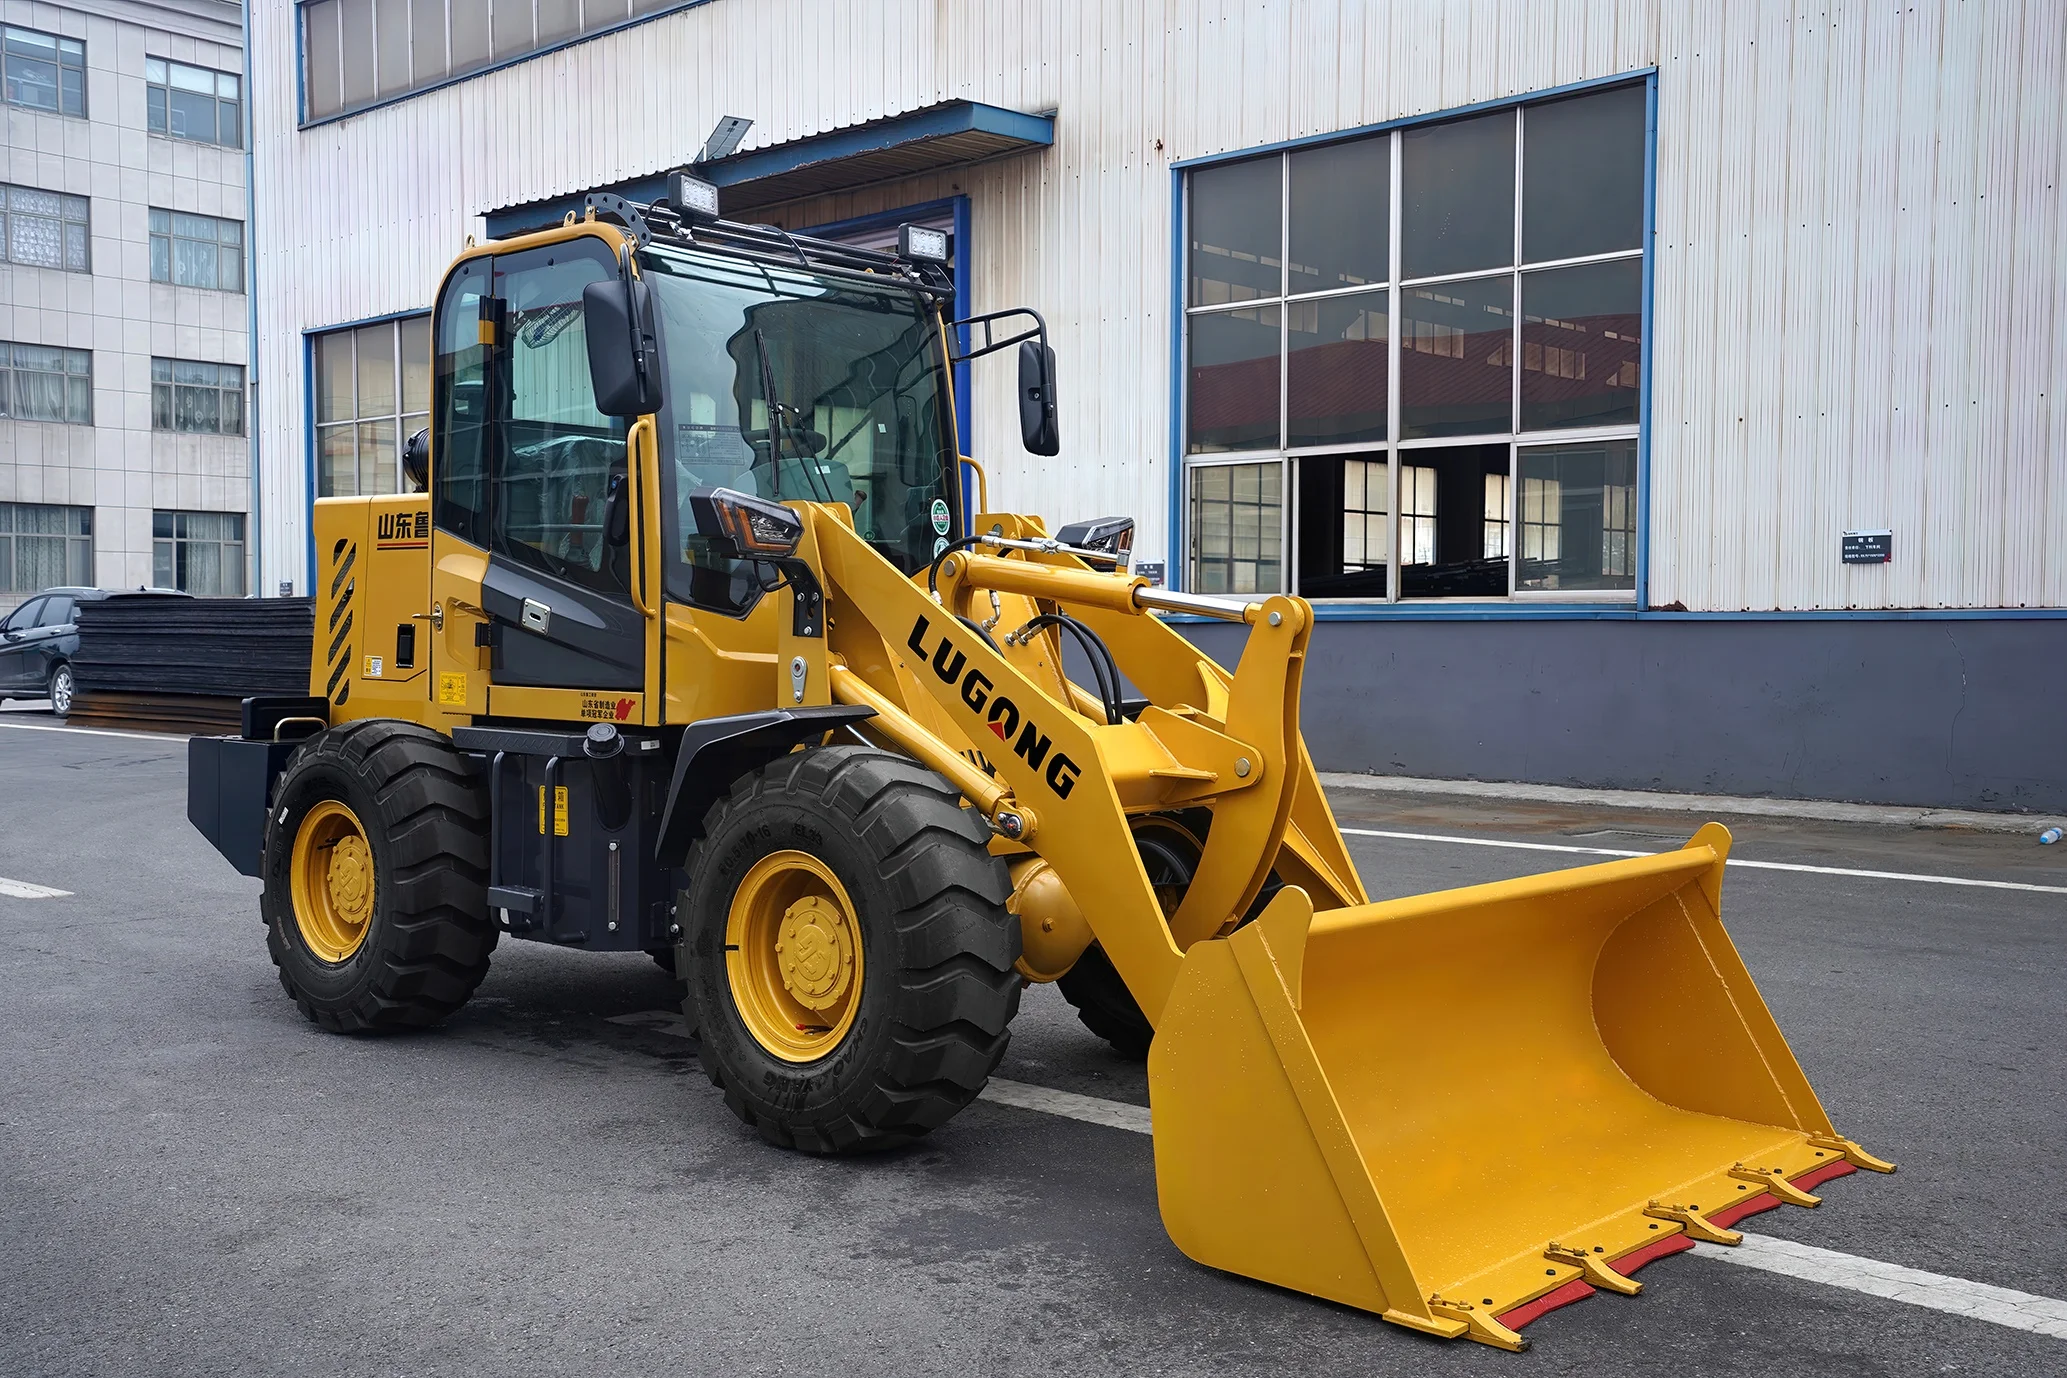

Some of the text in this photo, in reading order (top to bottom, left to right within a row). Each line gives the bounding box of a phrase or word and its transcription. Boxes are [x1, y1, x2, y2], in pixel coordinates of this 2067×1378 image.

[377, 511, 429, 540] 山东鲁
[580, 709, 614, 719] 单项冠军企业
[582, 699, 616, 710] 山东省制造业
[907, 614, 1082, 800] LUGONG
